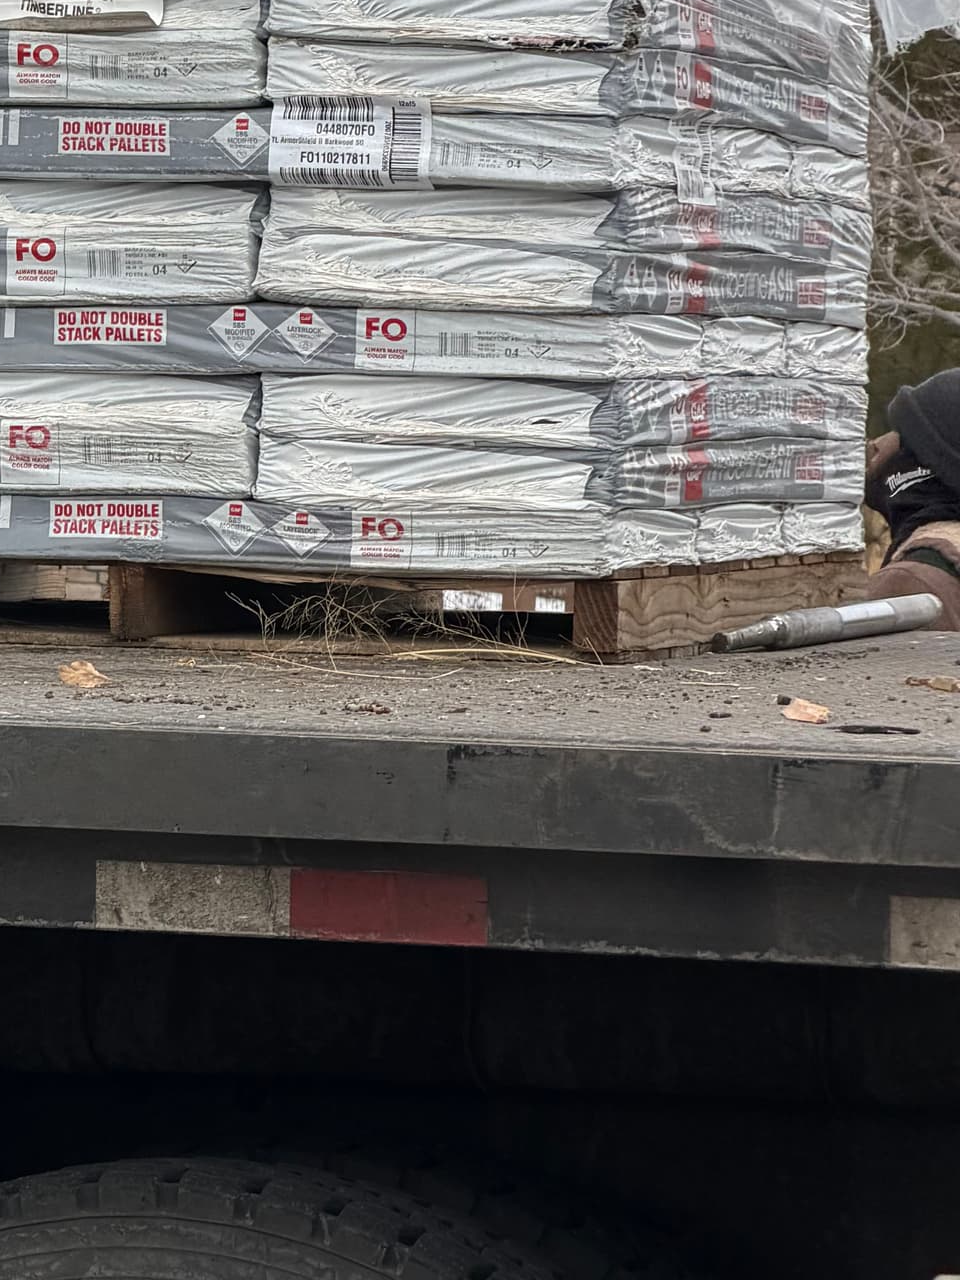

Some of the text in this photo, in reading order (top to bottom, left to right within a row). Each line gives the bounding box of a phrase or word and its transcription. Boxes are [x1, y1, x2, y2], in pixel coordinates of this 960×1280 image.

[18, 44, 60, 67] FO
[154, 67, 168, 78] 04
[63, 121, 166, 137] DO NOT DOUBLE
[63, 137, 166, 153] STACK PALLETS
[281, 137, 316, 145] ArmorShield
[16, 239, 56, 261] FO
[152, 264, 167, 275] 04
[58, 312, 163, 327] DO NOT DOUBLE
[58, 327, 162, 342] STACK PALLETS
[366, 318, 407, 341] FO
[505, 347, 519, 358] 04
[9, 425, 49, 449] FO
[54, 503, 159, 518] DO NOT DOUBLE
[54, 520, 159, 536] STACK PALLETS
[362, 518, 404, 540] FO
[502, 547, 517, 557] 04
